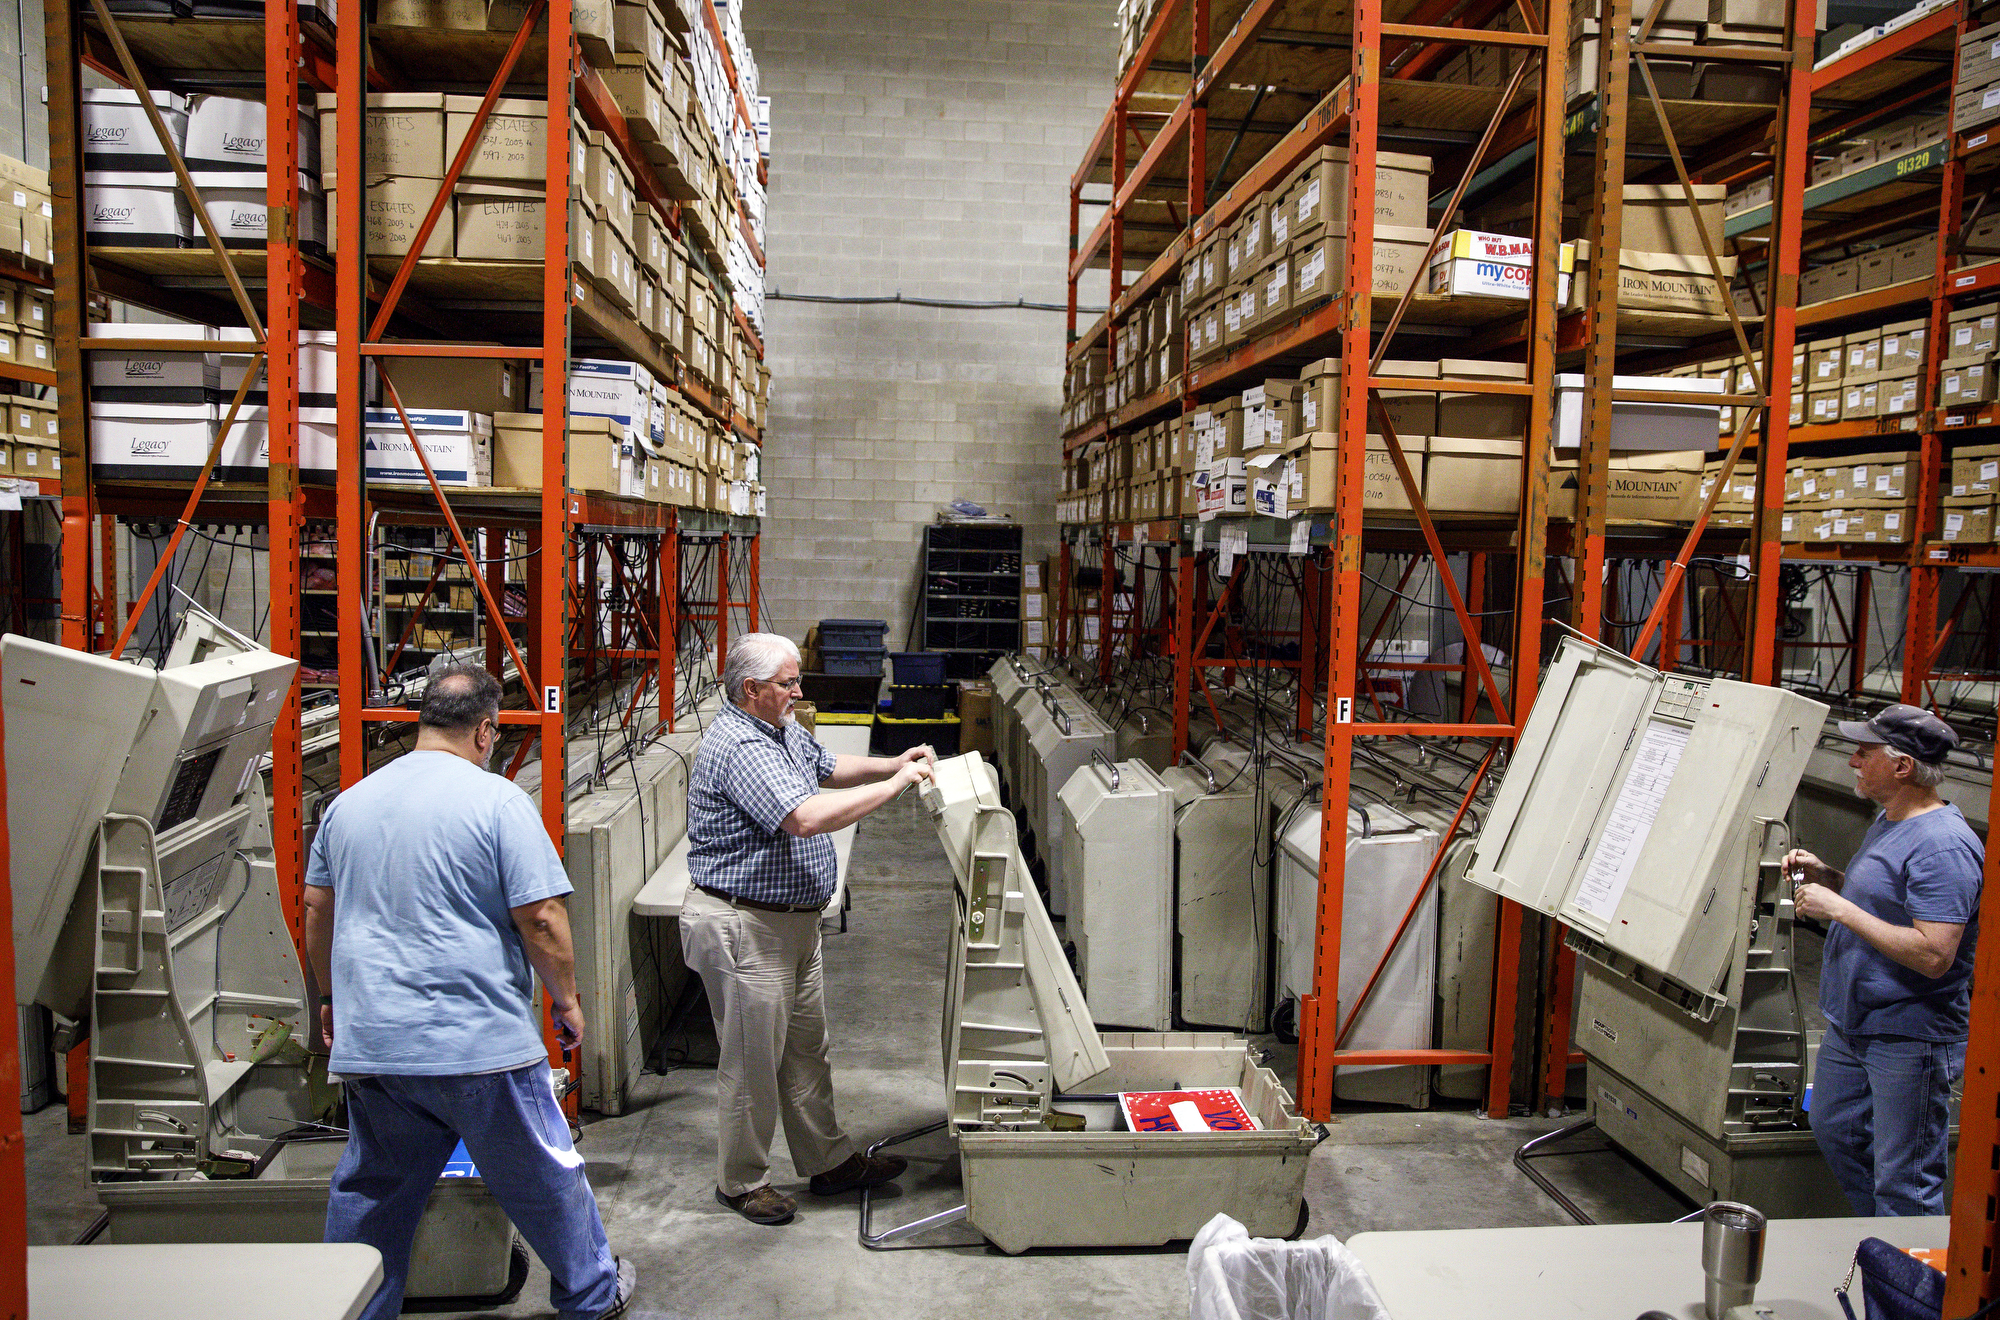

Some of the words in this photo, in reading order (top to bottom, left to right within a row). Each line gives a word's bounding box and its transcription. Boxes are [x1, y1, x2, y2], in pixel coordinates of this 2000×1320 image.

[87, 123, 128, 139] Legacy
[366, 116, 415, 132] STATES
[486, 117, 538, 132] ESTATES
[223, 132, 264, 149] Legacy
[1896, 151, 1930, 176] 91320
[93, 203, 133, 219] Legacy
[370, 200, 416, 214] ESTATES
[484, 198, 537, 216] ESTATES
[230, 209, 268, 226] Legacy
[1373, 246, 1400, 258] TATES
[1623, 277, 1649, 290] IRON
[1651, 280, 1712, 295] MOUNTAIN
[125, 358, 165, 374] Legacy
[576, 389, 620, 400] MOUNTAIN
[131, 437, 169, 453] Legacy
[380, 442, 402, 452] IRON
[1615, 479, 1678, 492] MOUNTAIN
[548, 689, 556, 710] E
[1341, 700, 1348, 721] F
